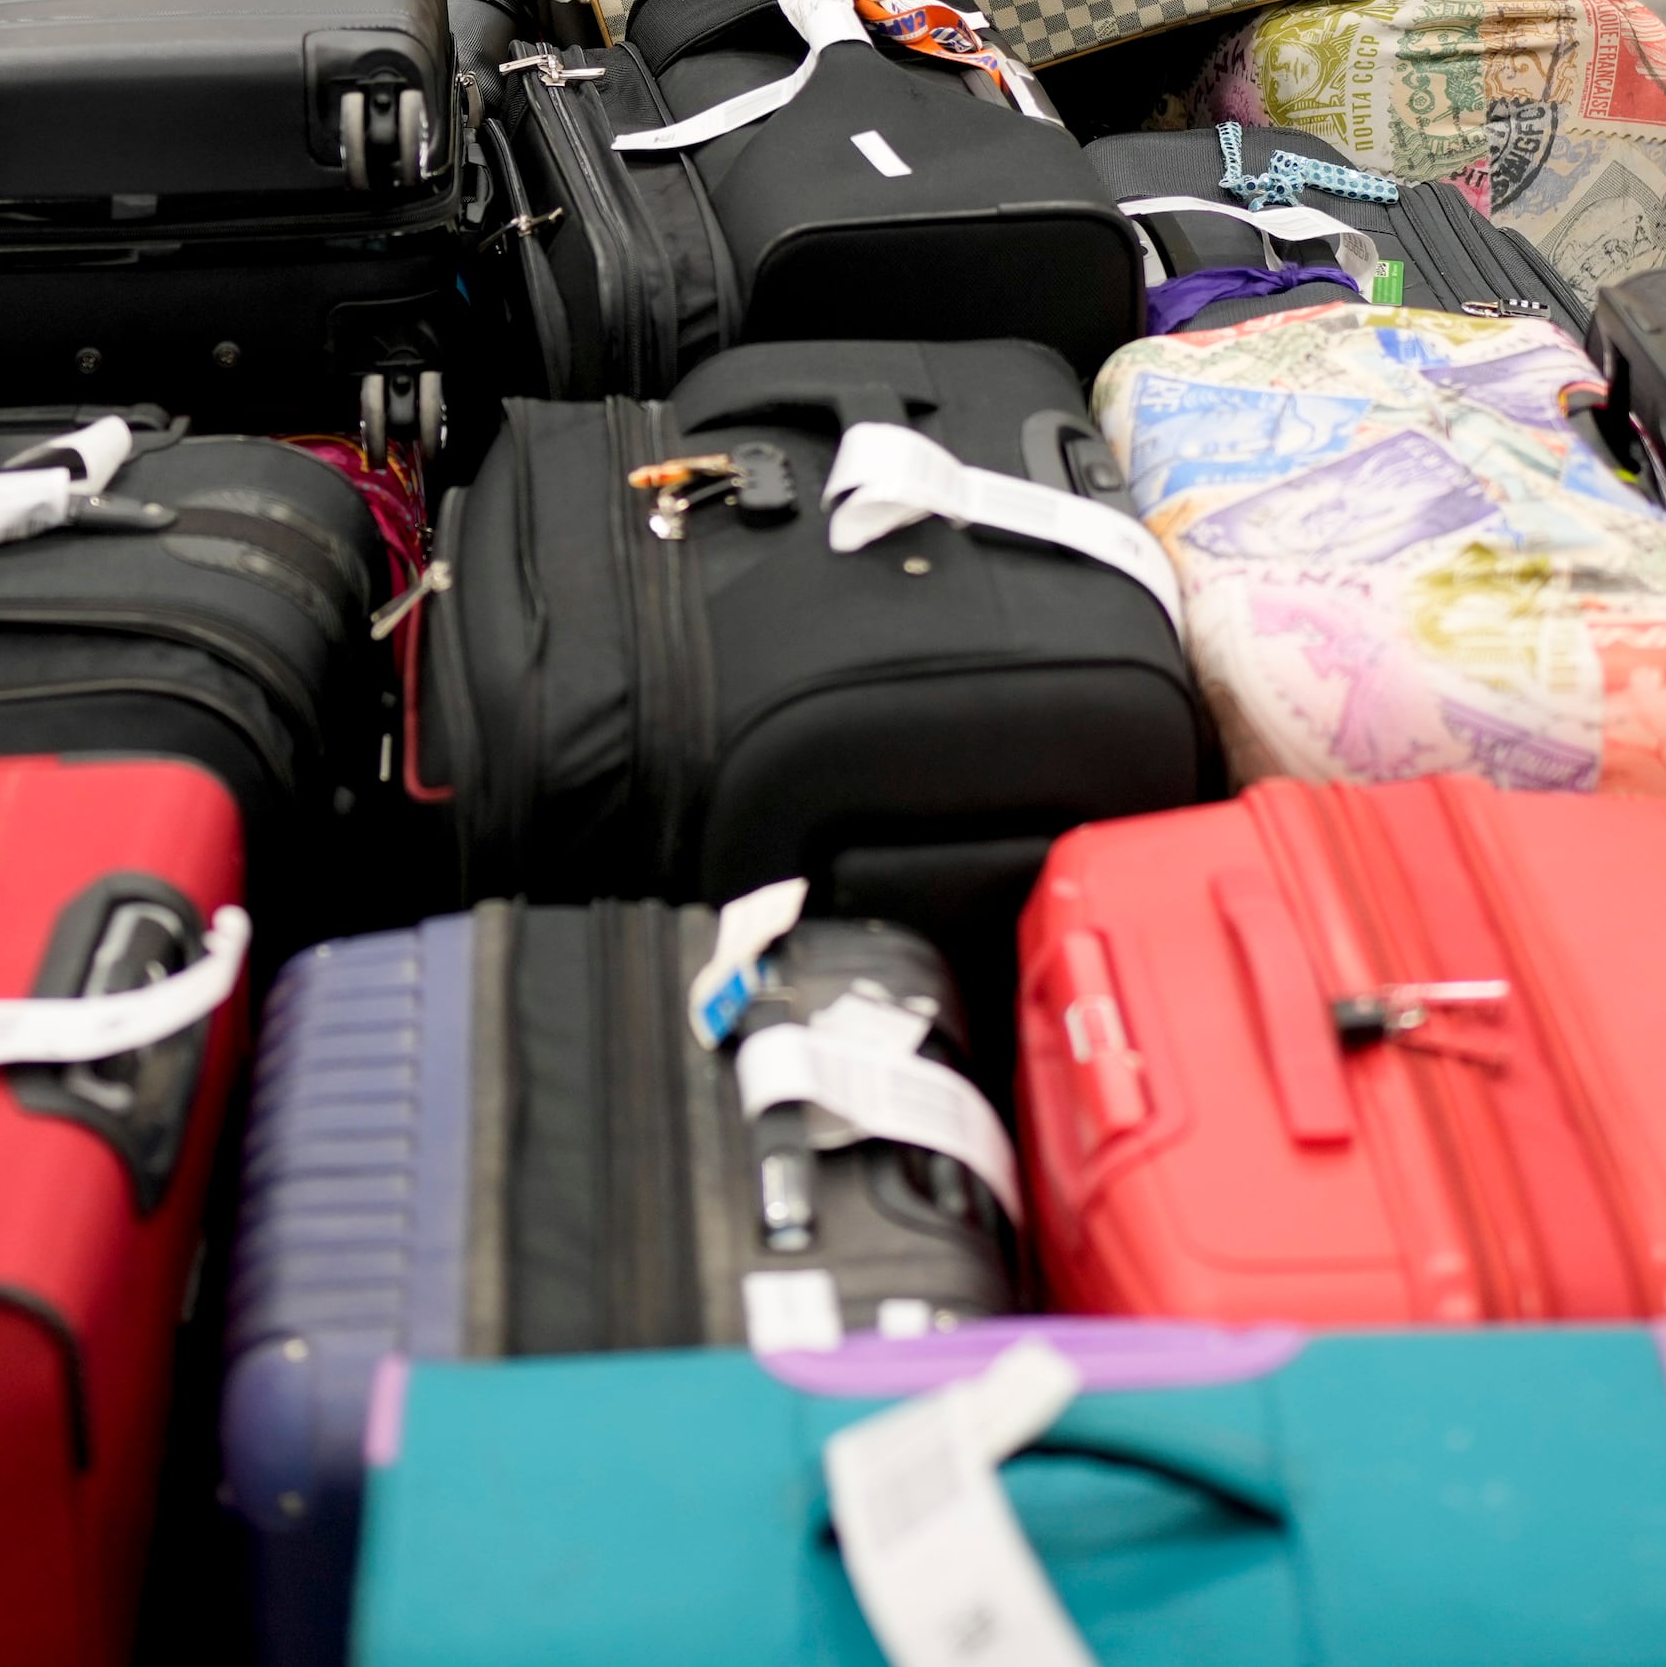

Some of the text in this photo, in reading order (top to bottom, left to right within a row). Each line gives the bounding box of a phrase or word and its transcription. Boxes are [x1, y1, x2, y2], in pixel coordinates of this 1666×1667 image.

[1350, 34, 1380, 152] ПОЧТА СССР
[1589, 45, 1620, 118] FRANÇAISE
